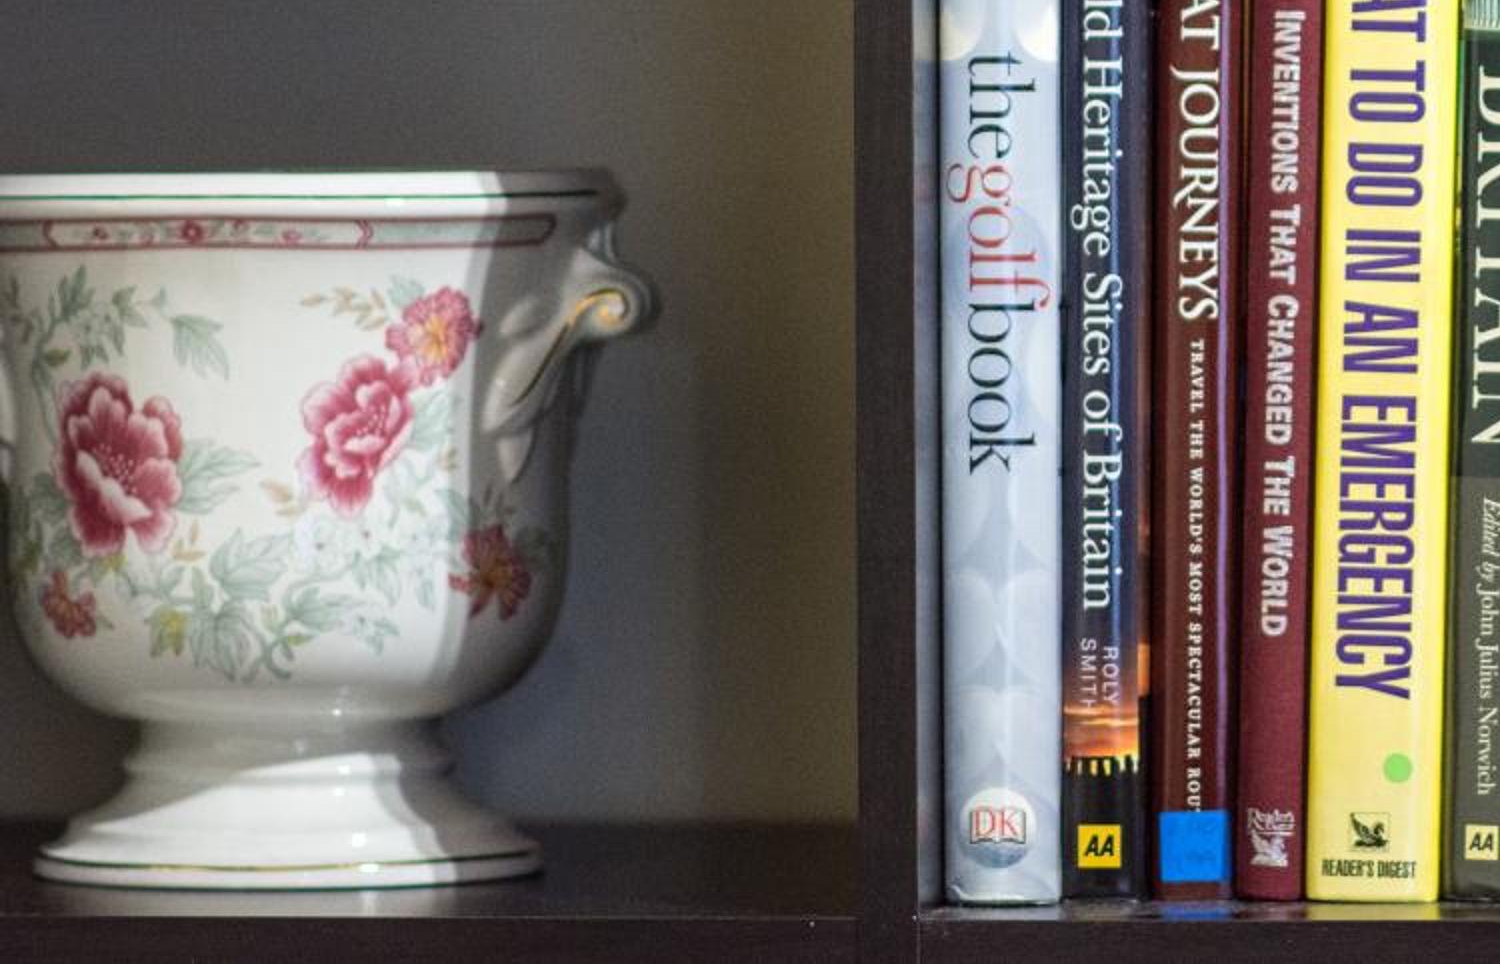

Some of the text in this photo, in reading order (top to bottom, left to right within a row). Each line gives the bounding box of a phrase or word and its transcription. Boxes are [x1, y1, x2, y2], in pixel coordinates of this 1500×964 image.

[1349, 60, 1426, 123] TO
[1071, 60, 1123, 258] Heritage
[1346, 143, 1423, 207] DO
[1170, 67, 1221, 322] JOURNEYS
[1344, 229, 1421, 282] IN
[1081, 274, 1123, 378] Sites
[1261, 10, 1305, 637] INVENTIONS THAT CHANGED THE WORLD
[1342, 300, 1419, 375] AN
[1081, 391, 1122, 442] of
[1082, 450, 1122, 611] Britain
[1335, 395, 1417, 700] EMERGENCY
[1185, 339, 1205, 812] TRAVEL THE WORLD'S MOST SPECTACULAR ROU
[1476, 564, 1500, 583] by
[1476, 583, 1500, 637] John
[1080, 638, 1097, 710] SMITH
[1102, 645, 1120, 706] ROLY
[1475, 639, 1499, 699] Julius
[1477, 706, 1499, 796] Norwich
[974, 809, 1026, 838] DK
[1083, 835, 1115, 856] AA
[1468, 832, 1494, 851] AA
[1322, 859, 1418, 878] READER'S DIGEST
